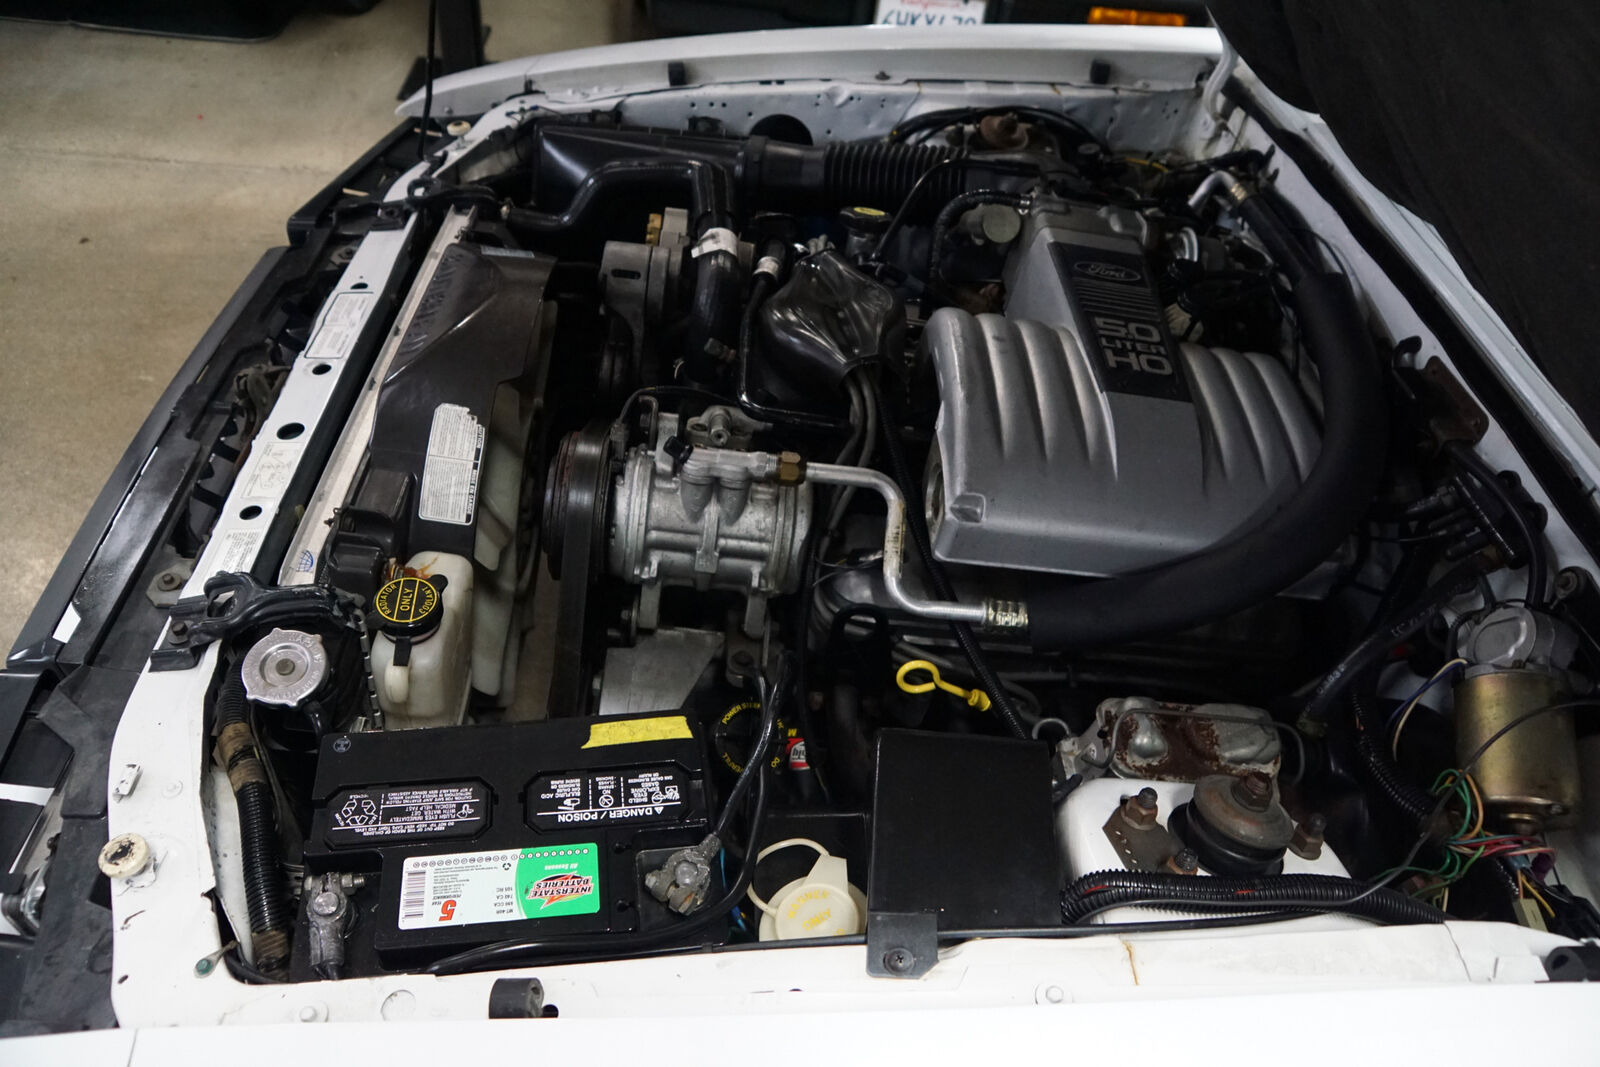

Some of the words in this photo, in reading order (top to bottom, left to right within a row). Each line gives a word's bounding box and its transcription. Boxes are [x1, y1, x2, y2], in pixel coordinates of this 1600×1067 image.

[1088, 264, 1126, 279] Ford
[1095, 317, 1160, 342] 5.0
[1101, 338, 1167, 355] LITER
[1104, 348, 1173, 375] HO
[380, 583, 397, 615] RADIATOR
[400, 588, 412, 612] ONLY
[418, 586, 434, 614] COOLANT
[722, 704, 742, 725] POWER
[558, 812, 598, 822] POISON
[609, 808, 653, 819] DANGER
[531, 887, 591, 897] INTERSTATE
[536, 879, 589, 889] BATTERIES
[438, 900, 456, 921] 5
[802, 908, 832, 931] ONLY
